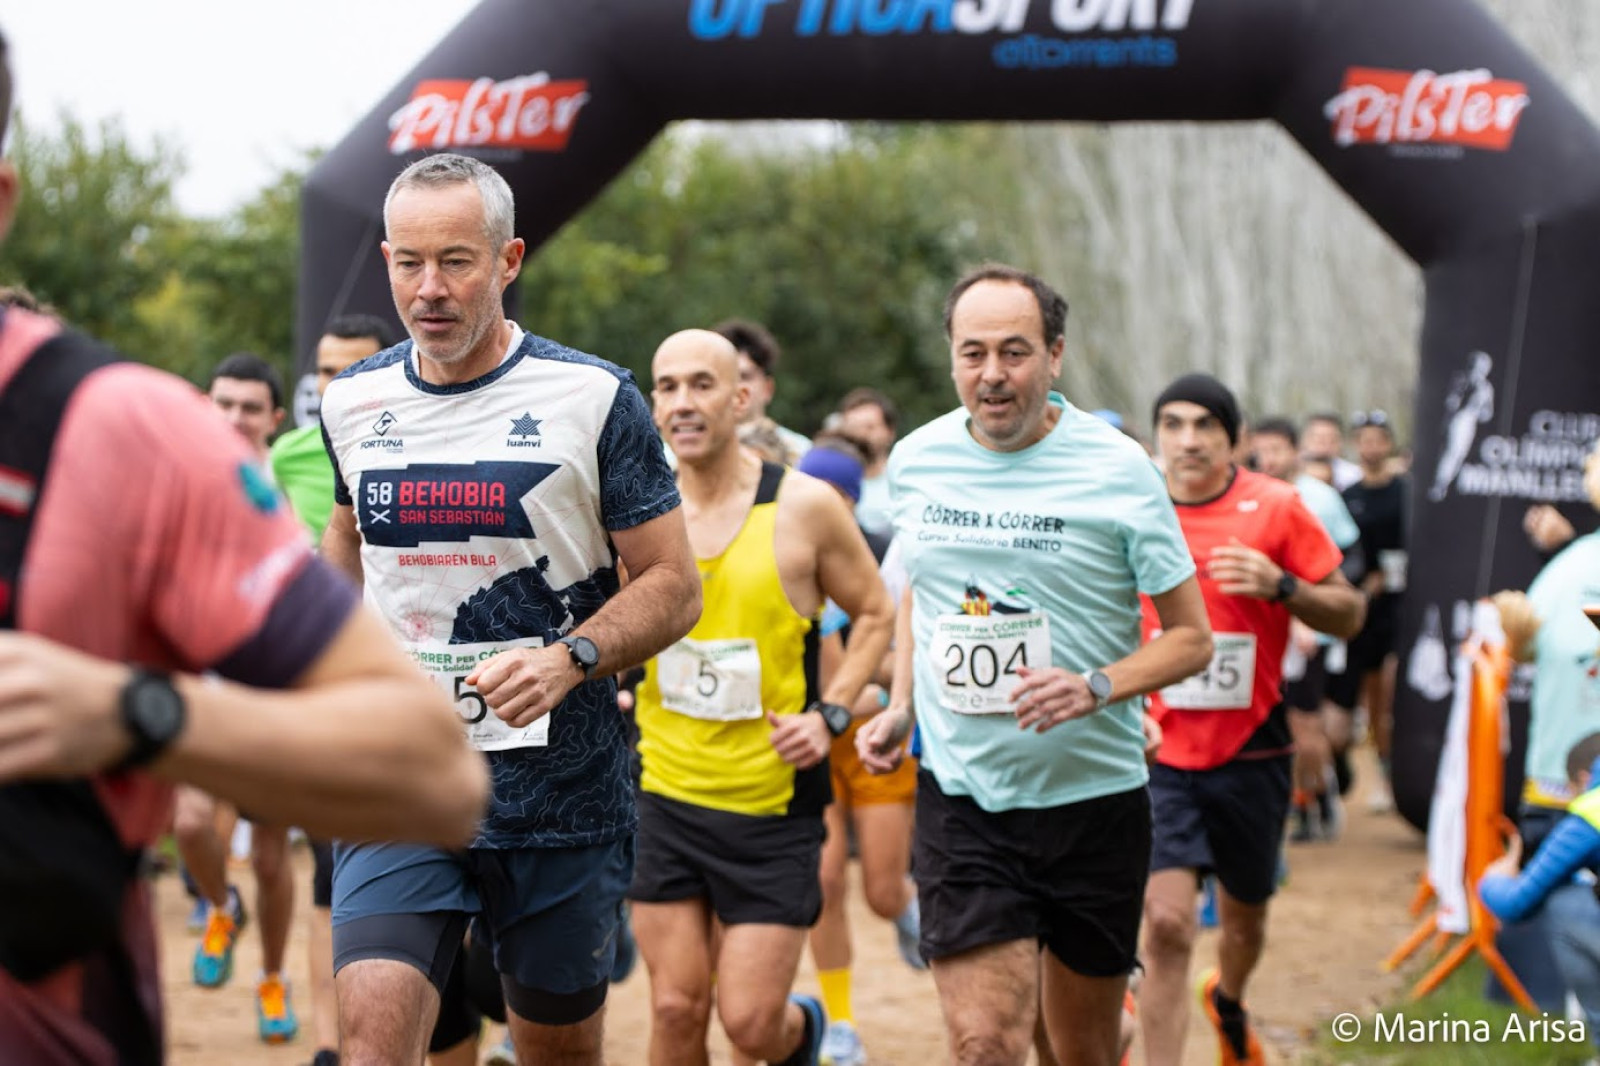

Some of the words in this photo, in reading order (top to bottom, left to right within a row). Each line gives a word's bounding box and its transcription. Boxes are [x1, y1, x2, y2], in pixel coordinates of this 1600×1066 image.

[360, 438, 404, 450] FORTUNA
[506, 439, 541, 448] luanvi
[1458, 463, 1590, 501] MANLLE
[367, 482, 392, 506] 58
[399, 481, 506, 508] BEHOBIA
[399, 509, 426, 524] SAN
[1012, 537, 1062, 552] BENITO
[399, 554, 467, 567] BEHOBIAREN
[470, 554, 496, 566] BILA
[456, 656, 475, 664] PER
[944, 641, 1028, 688] 204
[697, 660, 719, 697] 5
